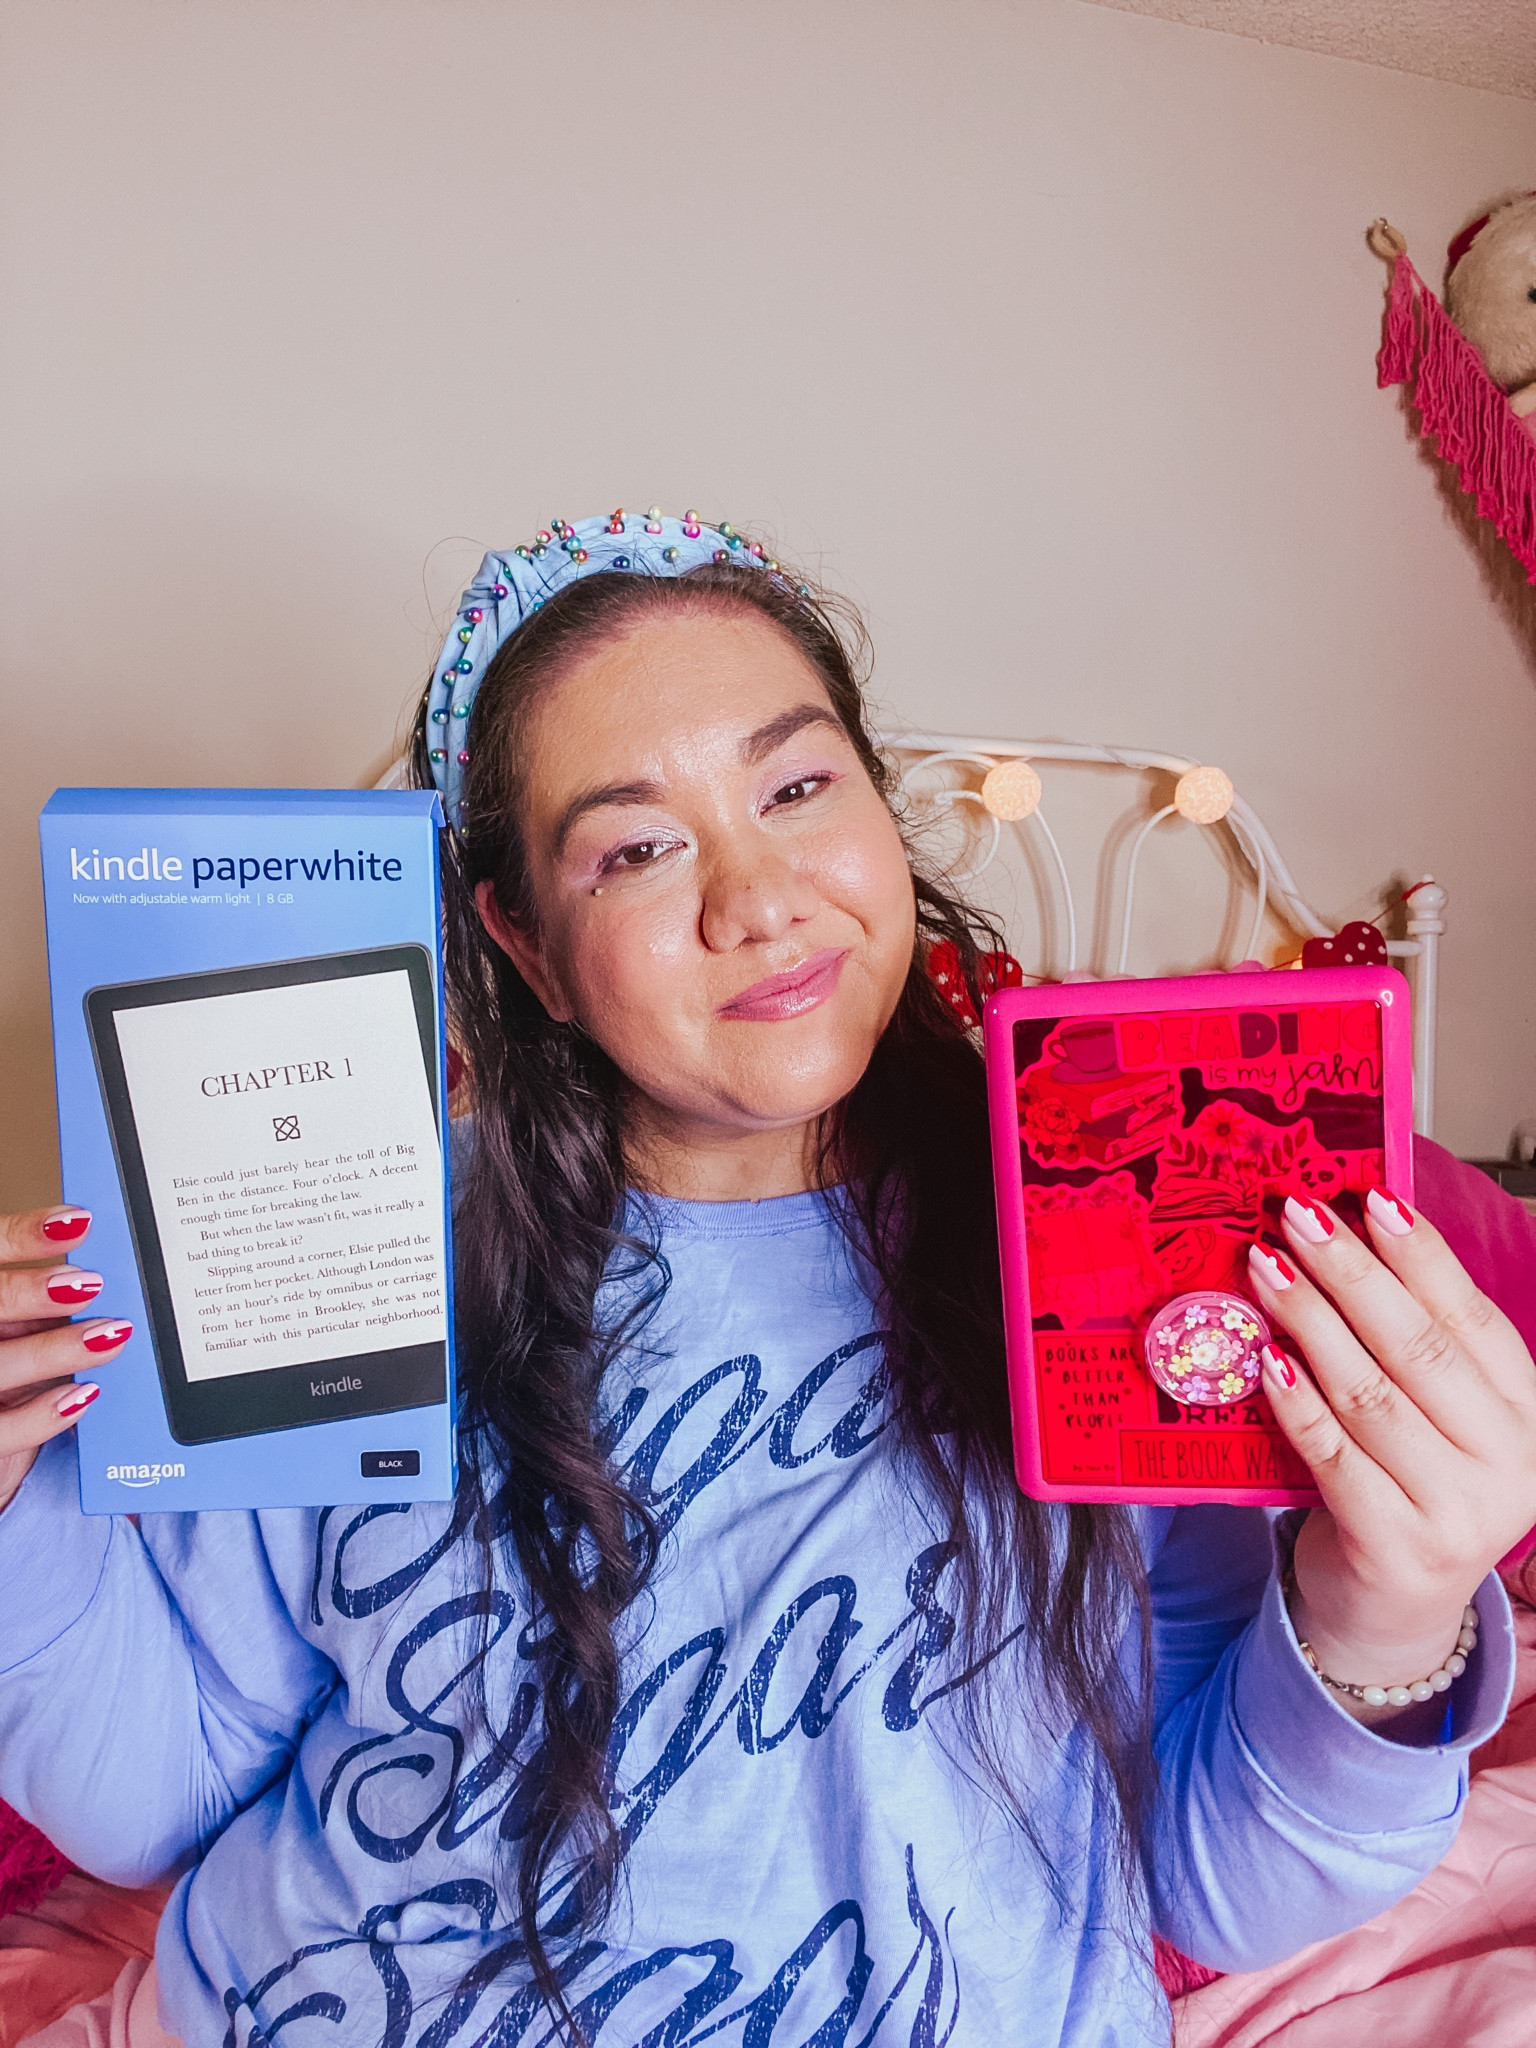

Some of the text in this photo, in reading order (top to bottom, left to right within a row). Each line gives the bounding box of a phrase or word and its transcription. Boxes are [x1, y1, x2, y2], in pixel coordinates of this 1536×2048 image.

[70, 847, 403, 890] kindle paperwhite
[73, 894, 99, 904] Now
[102, 893, 127, 904] with
[130, 892, 188, 907] adjustable
[190, 895, 222, 904] warm
[225, 892, 251, 907] light
[267, 894, 274, 904] 8
[278, 893, 294, 904] GB
[1120, 1005, 1381, 1067] READING
[201, 1057, 354, 1097] CHAPTER 1
[1209, 1053, 1382, 1106] is my jam
[173, 1144, 415, 1189] Elsie could just barely hear the toll of Big
[176, 1162, 418, 1207] Ben in the distance. Four o'clock. A decent
[180, 1189, 362, 1226] enough time for breaking the law.
[200, 1199, 424, 1242] But when the law wasn't fit, was it really a
[187, 1235, 303, 1262] bad thing to break it?
[207, 1233, 431, 1279] Slipping around a corner, Elsie pulled the
[194, 1254, 435, 1299] letter from her pocket. Although London was
[198, 1271, 437, 1317] only an hour's ride by omnibus or carriage
[201, 1287, 441, 1335] from her home in Brookley, she was not
[205, 1305, 443, 1352] familiar with this particular neighborhood.
[1045, 1347, 1099, 1363] BOOKS
[310, 1376, 363, 1397] kindle
[1063, 1370, 1125, 1384] BETTER
[1073, 1392, 1120, 1406] THAN
[1066, 1414, 1123, 1428] PEOPLE
[106, 1463, 186, 1481] amazon
[378, 1460, 404, 1468] BLACK
[1134, 1440, 1168, 1480] THE
[1176, 1440, 1236, 1480] BOOK
